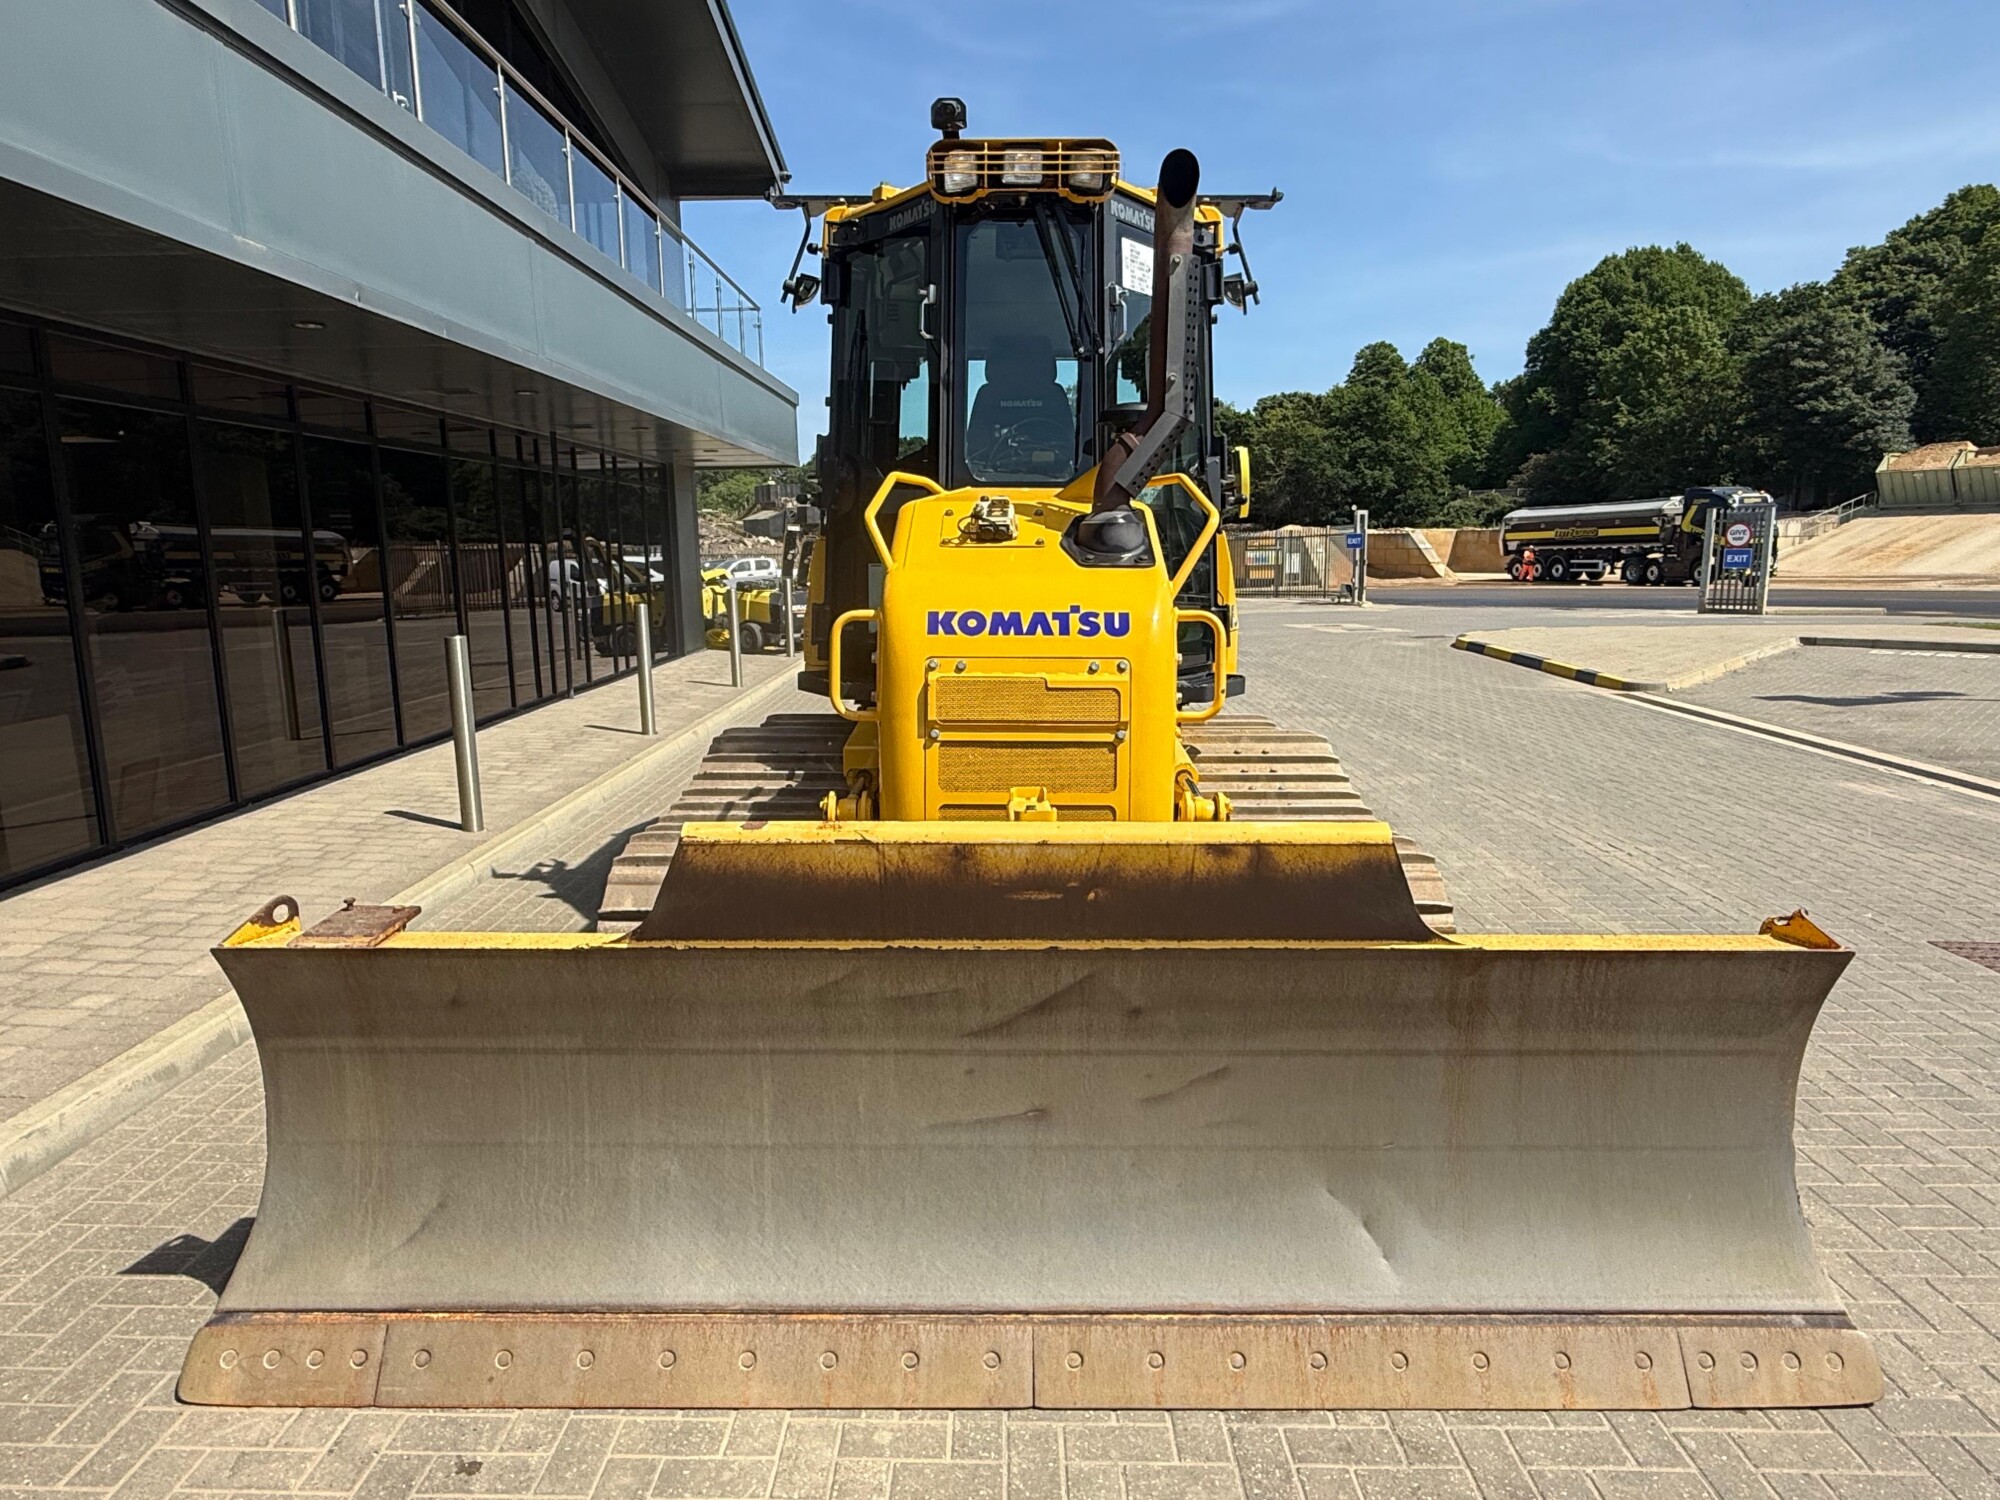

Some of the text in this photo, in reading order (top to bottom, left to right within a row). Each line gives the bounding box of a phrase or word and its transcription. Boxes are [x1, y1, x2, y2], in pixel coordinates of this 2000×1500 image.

[889, 199, 937, 231] KOMATSU
[1726, 554, 1749, 563] EXIT
[927, 604, 1131, 638] KOMATSU
